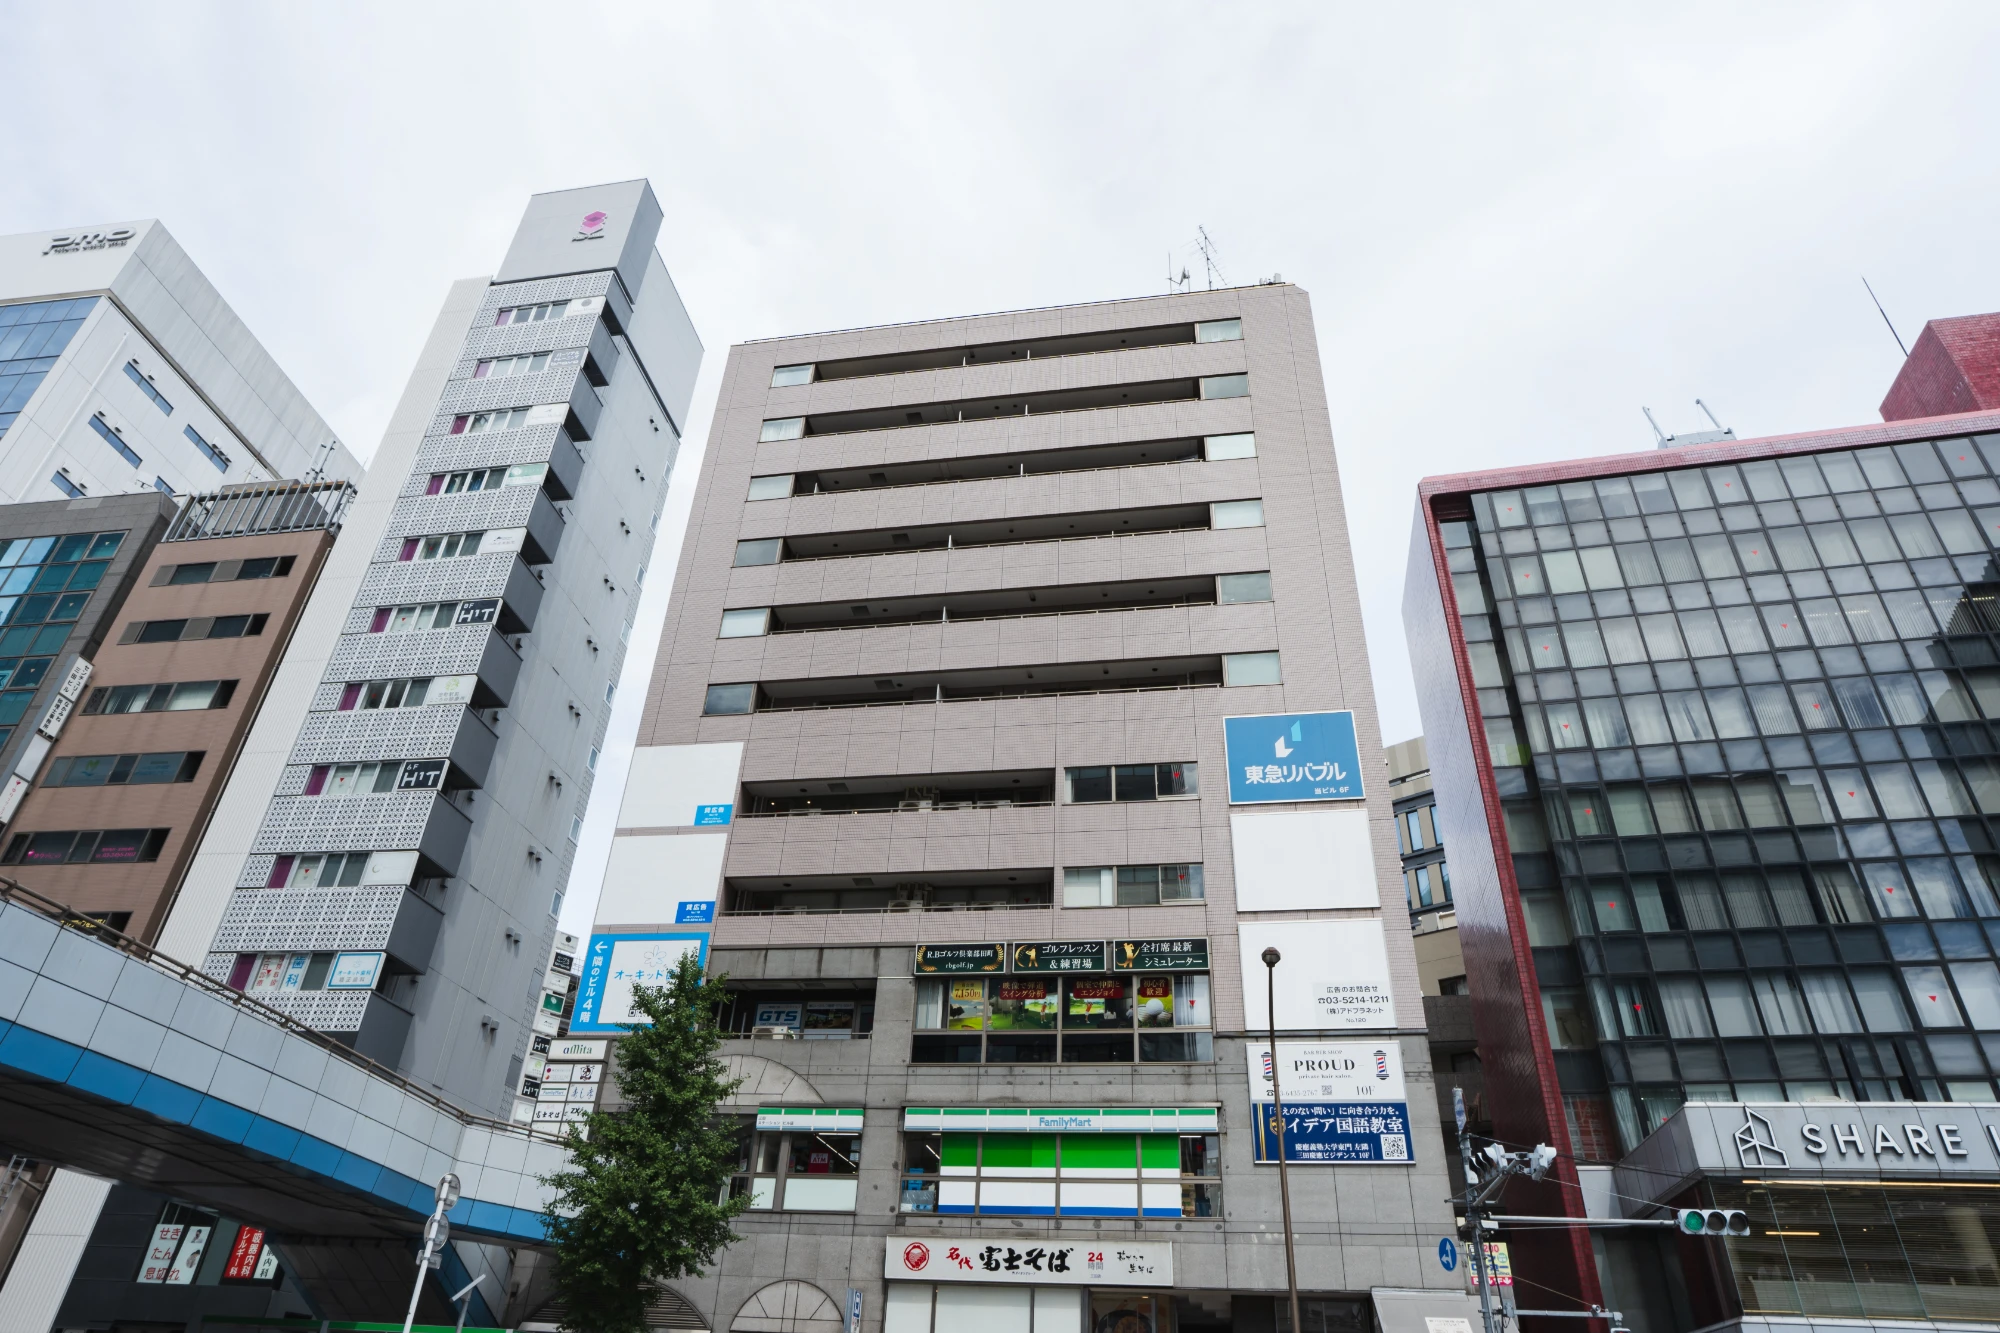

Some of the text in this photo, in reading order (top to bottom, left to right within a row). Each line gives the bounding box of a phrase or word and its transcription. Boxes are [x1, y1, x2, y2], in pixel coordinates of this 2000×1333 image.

[63, 667, 80, 692] 三田ビル
[71, 665, 89, 696] センチュリー
[1245, 762, 1347, 784] 東急リバブル
[1042, 944, 1099, 954] ゴルフレッスン
[1141, 941, 1192, 953] 全打席 最新
[946, 962, 974, 970] rbgolf.jp
[1050, 958, 1092, 969] &練習場
[1145, 957, 1202, 967] シミュレーター
[286, 956, 306, 987] 歯科
[579, 955, 604, 1023] 隣のビル4階
[1002, 982, 1044, 990] 映像で弾道
[1076, 981, 1120, 989] 個室で仲間と
[1327, 985, 1378, 993] 広告のお問合せ
[955, 988, 981, 998] 7,150円
[1002, 990, 1044, 998] スイング分析
[1081, 988, 1115, 996] エンジョイ
[1146, 988, 1163, 996] 歓迎
[1325, 996, 1389, 1004] 03-5214-1211
[759, 1011, 798, 1021] GTS
[1294, 1059, 1355, 1071] PROUD
[1039, 1117, 1091, 1129] FamilyMart
[1287, 1117, 1404, 1134] イデア国語教室
[1801, 1123, 1969, 1155] SHARE
[160, 1228, 181, 1239] せき
[229, 1227, 250, 1276] レルギー科
[241, 1230, 262, 1276] 吸器内科
[1088, 1252, 1103, 1262] 24
[946, 1246, 1074, 1273] 名代 富士そば
[1088, 1262, 1103, 1270] 時間
[144, 1267, 180, 1280] 息切れ
